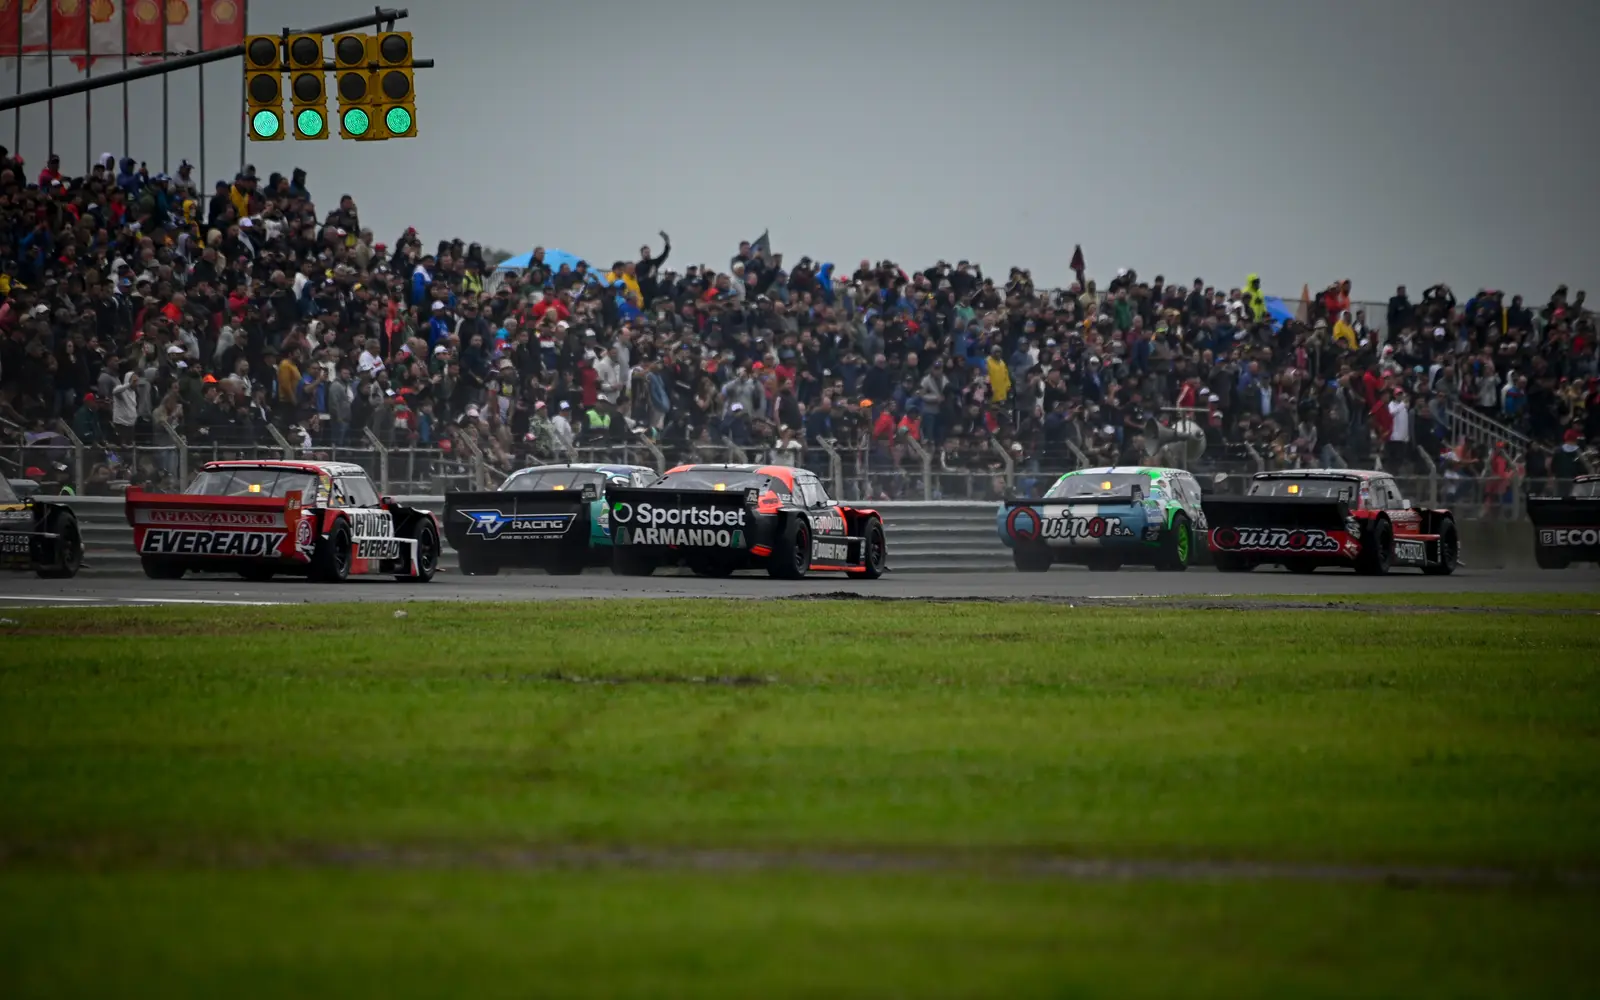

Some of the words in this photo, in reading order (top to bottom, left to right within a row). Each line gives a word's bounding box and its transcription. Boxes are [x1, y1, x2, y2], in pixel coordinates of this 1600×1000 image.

[154, 510, 272, 525] AFIANZADORA
[476, 515, 504, 534] RV
[512, 520, 563, 529] RACING
[636, 502, 746, 528] Sportsbet
[1006, 506, 1120, 541] Quinor
[141, 529, 285, 556] EVEREADY
[632, 527, 731, 548] ARMANDO
[1556, 529, 1600, 546] ECO
